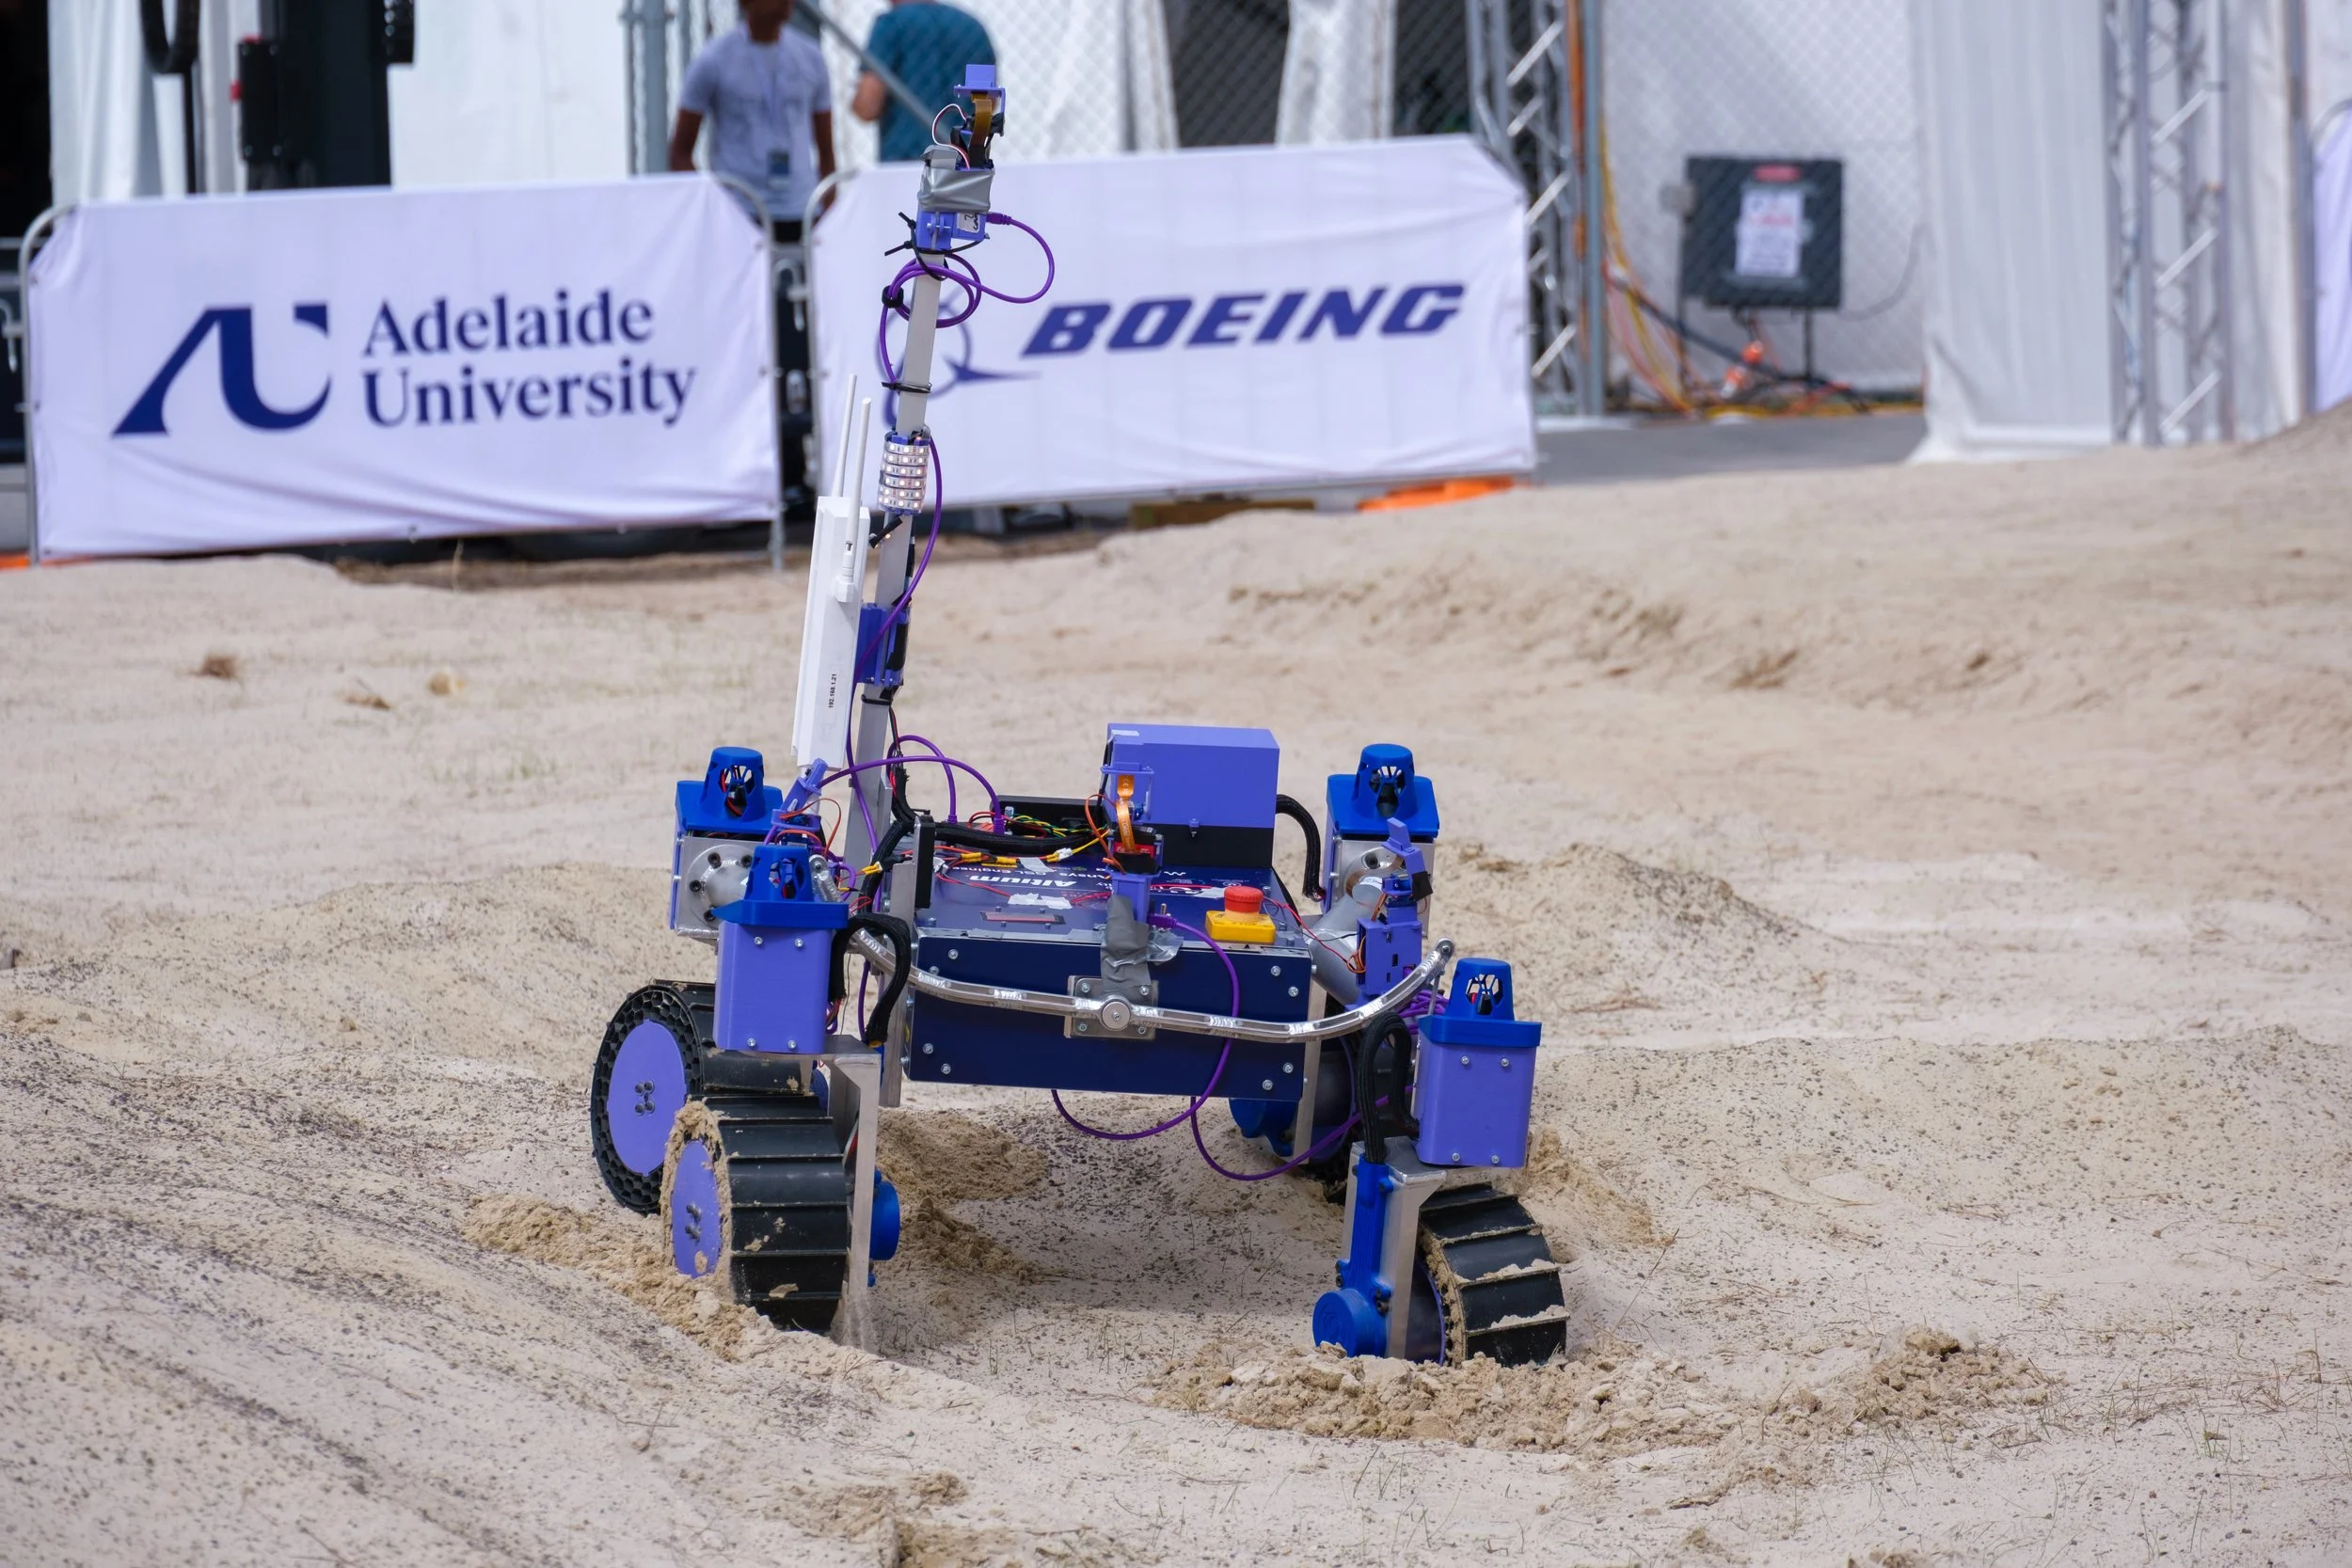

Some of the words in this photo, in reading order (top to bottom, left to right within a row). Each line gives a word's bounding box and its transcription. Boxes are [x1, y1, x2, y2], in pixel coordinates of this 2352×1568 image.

[362, 287, 656, 358] Adelaide
[1019, 282, 1466, 356] BOEING
[361, 355, 697, 429] University
[969, 875, 1077, 887] Altium
